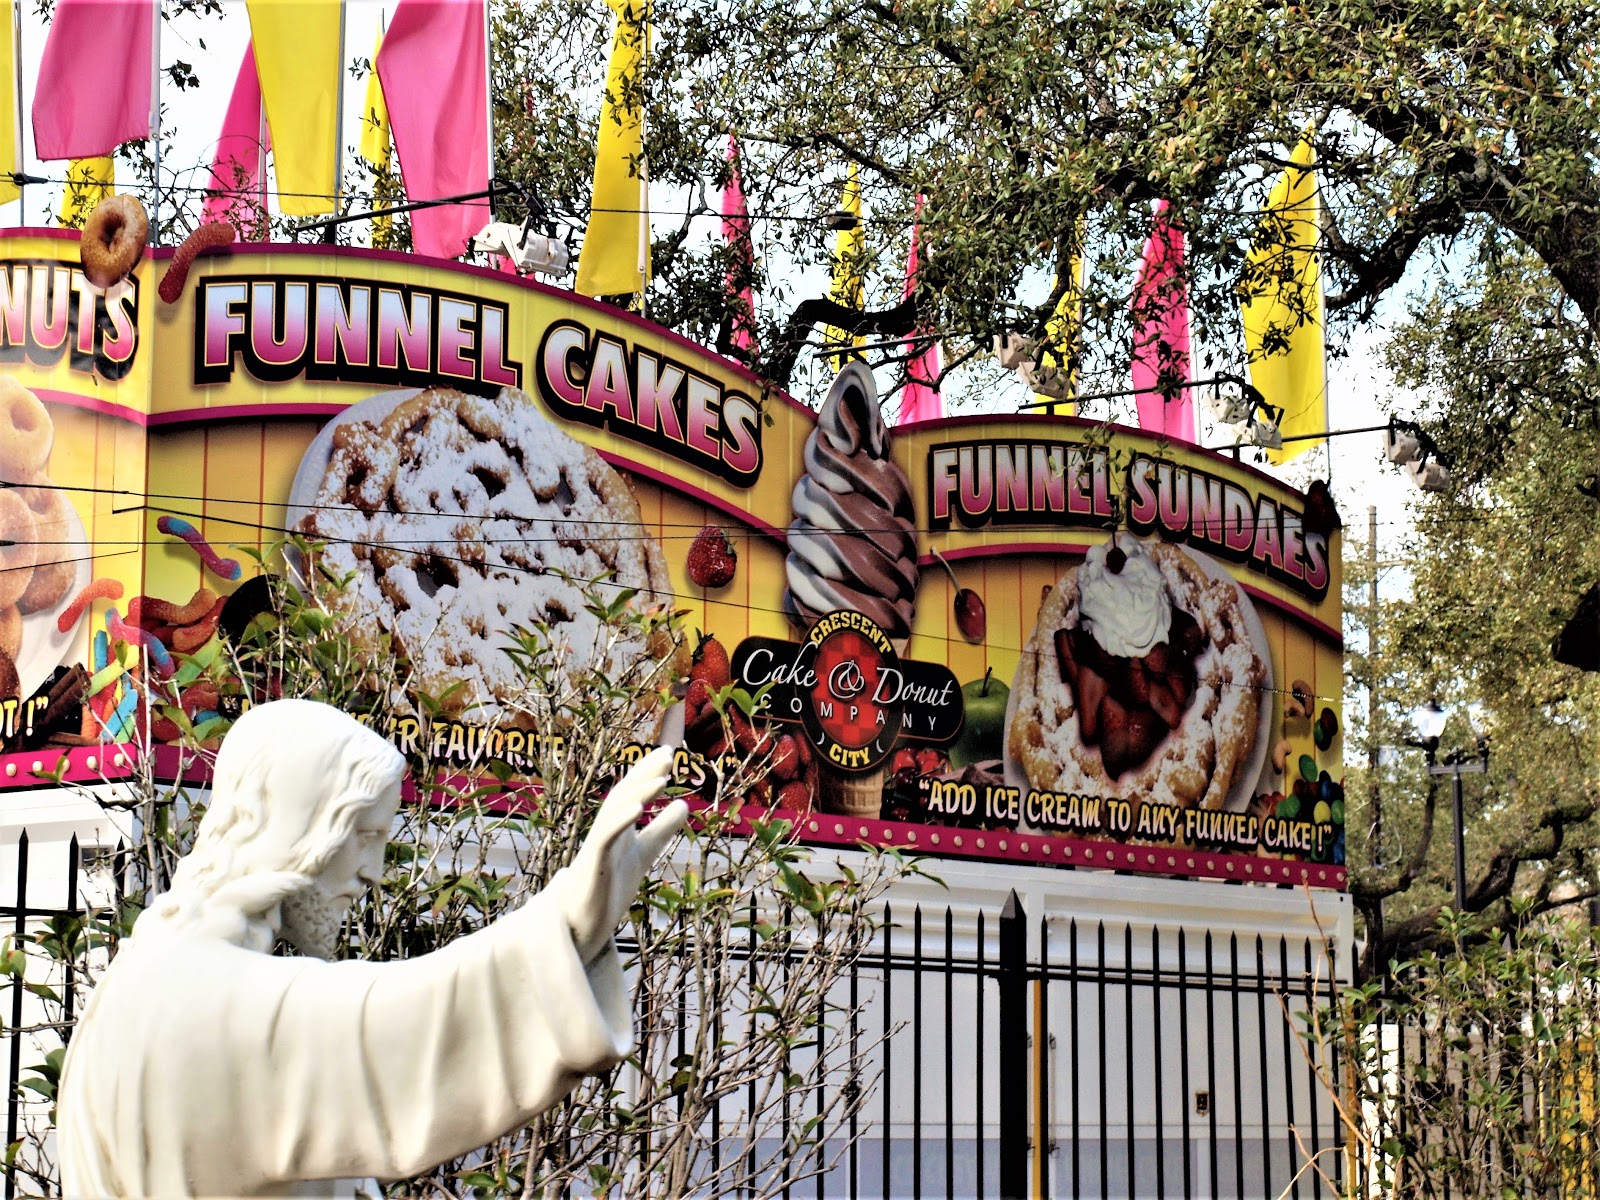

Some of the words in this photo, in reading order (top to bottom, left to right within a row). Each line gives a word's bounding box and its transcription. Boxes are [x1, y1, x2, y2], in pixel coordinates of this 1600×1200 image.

[204, 280, 518, 388] FUNNEL
[544, 326, 759, 474] CAKES
[933, 445, 1112, 518] FUNNEL
[1131, 458, 1328, 590] SUNDAES
[809, 611, 892, 654] CRESCENT
[743, 641, 818, 687] Cake
[828, 659, 864, 699] &
[872, 667, 953, 707] Donut
[760, 693, 936, 731] COMPANY
[829, 743, 869, 768] CITY
[919, 779, 977, 817] “ADD
[985, 787, 1019, 821] ICE
[1027, 792, 1101, 828] CREAM
[1107, 800, 1131, 831] TO
[1138, 804, 1180, 838] ANY
[1185, 809, 1259, 844] FUNNEL
